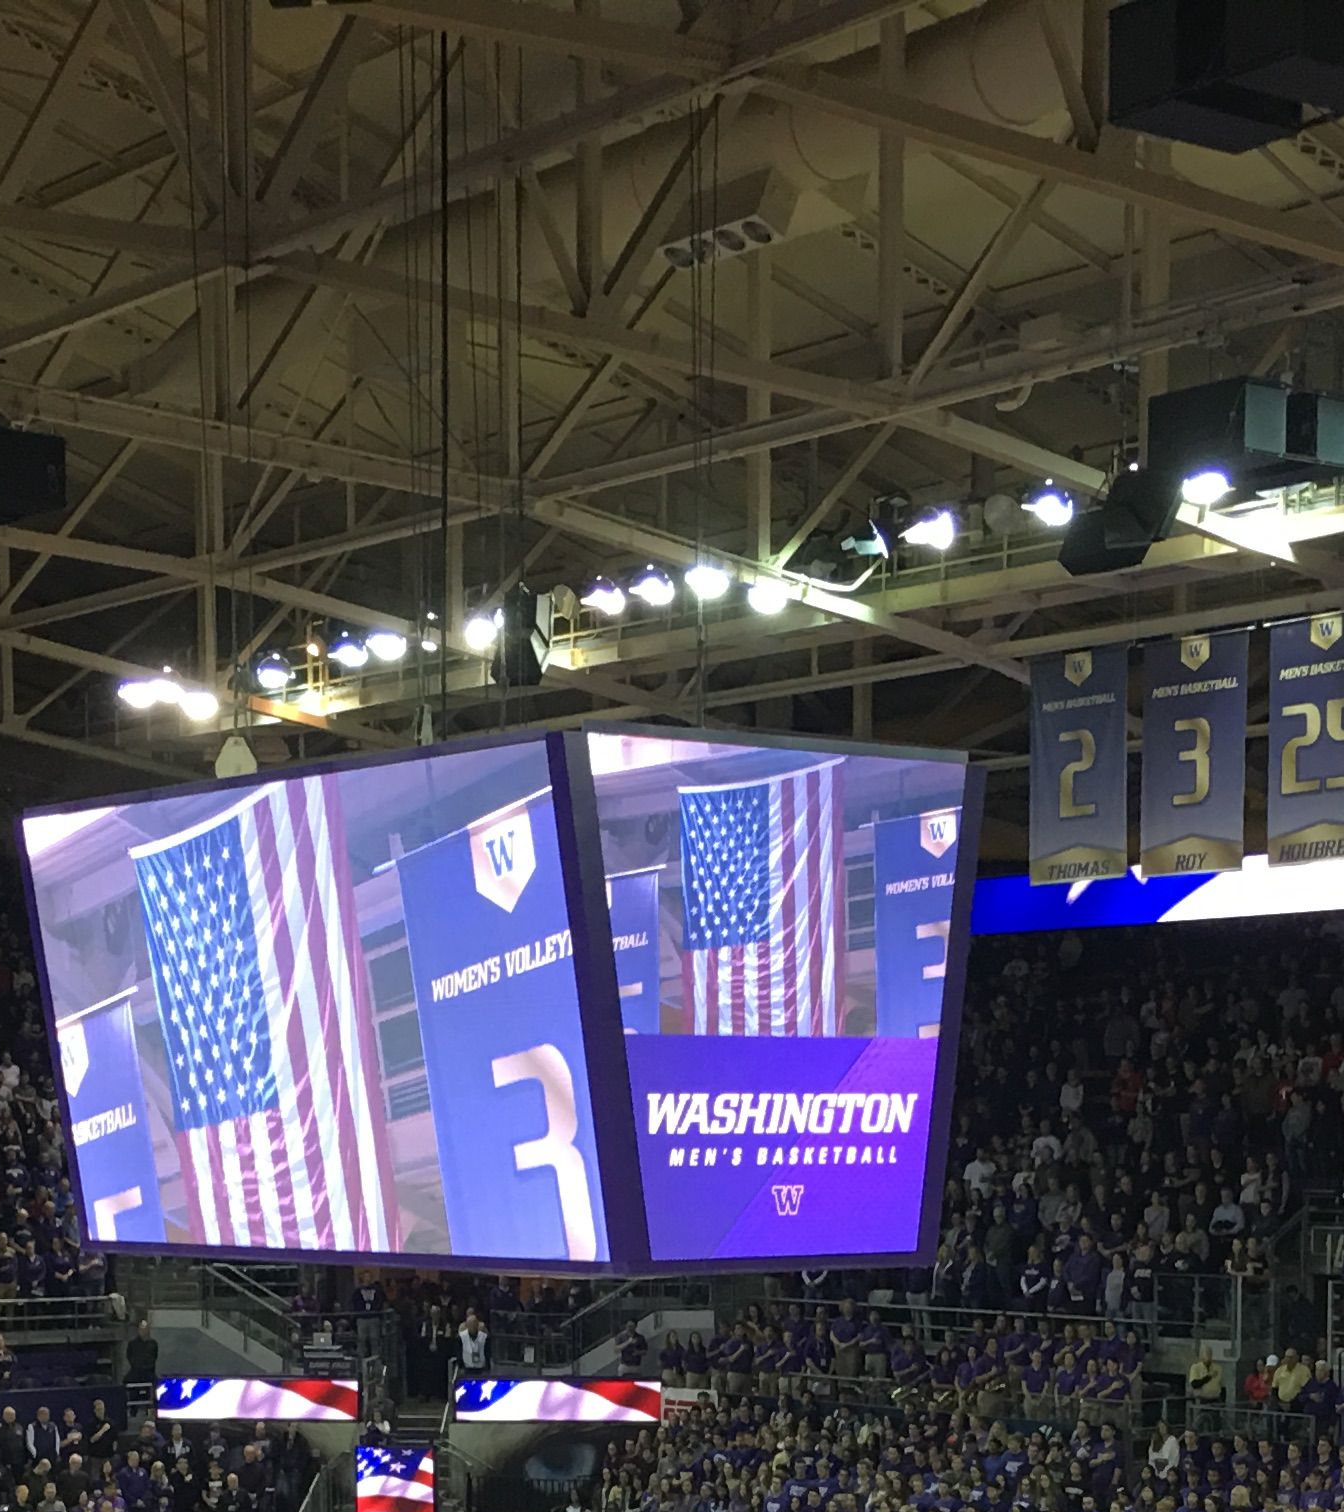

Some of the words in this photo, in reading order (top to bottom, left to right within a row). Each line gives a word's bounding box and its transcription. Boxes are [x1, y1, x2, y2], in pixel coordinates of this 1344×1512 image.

[1319, 620, 1334, 637] W
[1181, 677, 1238, 695] BASKETBALL
[1059, 729, 1096, 818] 2
[1172, 717, 1211, 806] 3
[486, 830, 514, 878] W
[1048, 860, 1110, 880] THOMAS
[1175, 852, 1207, 871] ROY
[431, 957, 501, 1003] WOMEN'S
[647, 1093, 918, 1135] WASHINGTON
[491, 1042, 596, 1261] 3
[669, 1147, 743, 1167] MEN'S
[757, 1145, 897, 1166] BASKETBALL
[772, 1185, 804, 1216] W
